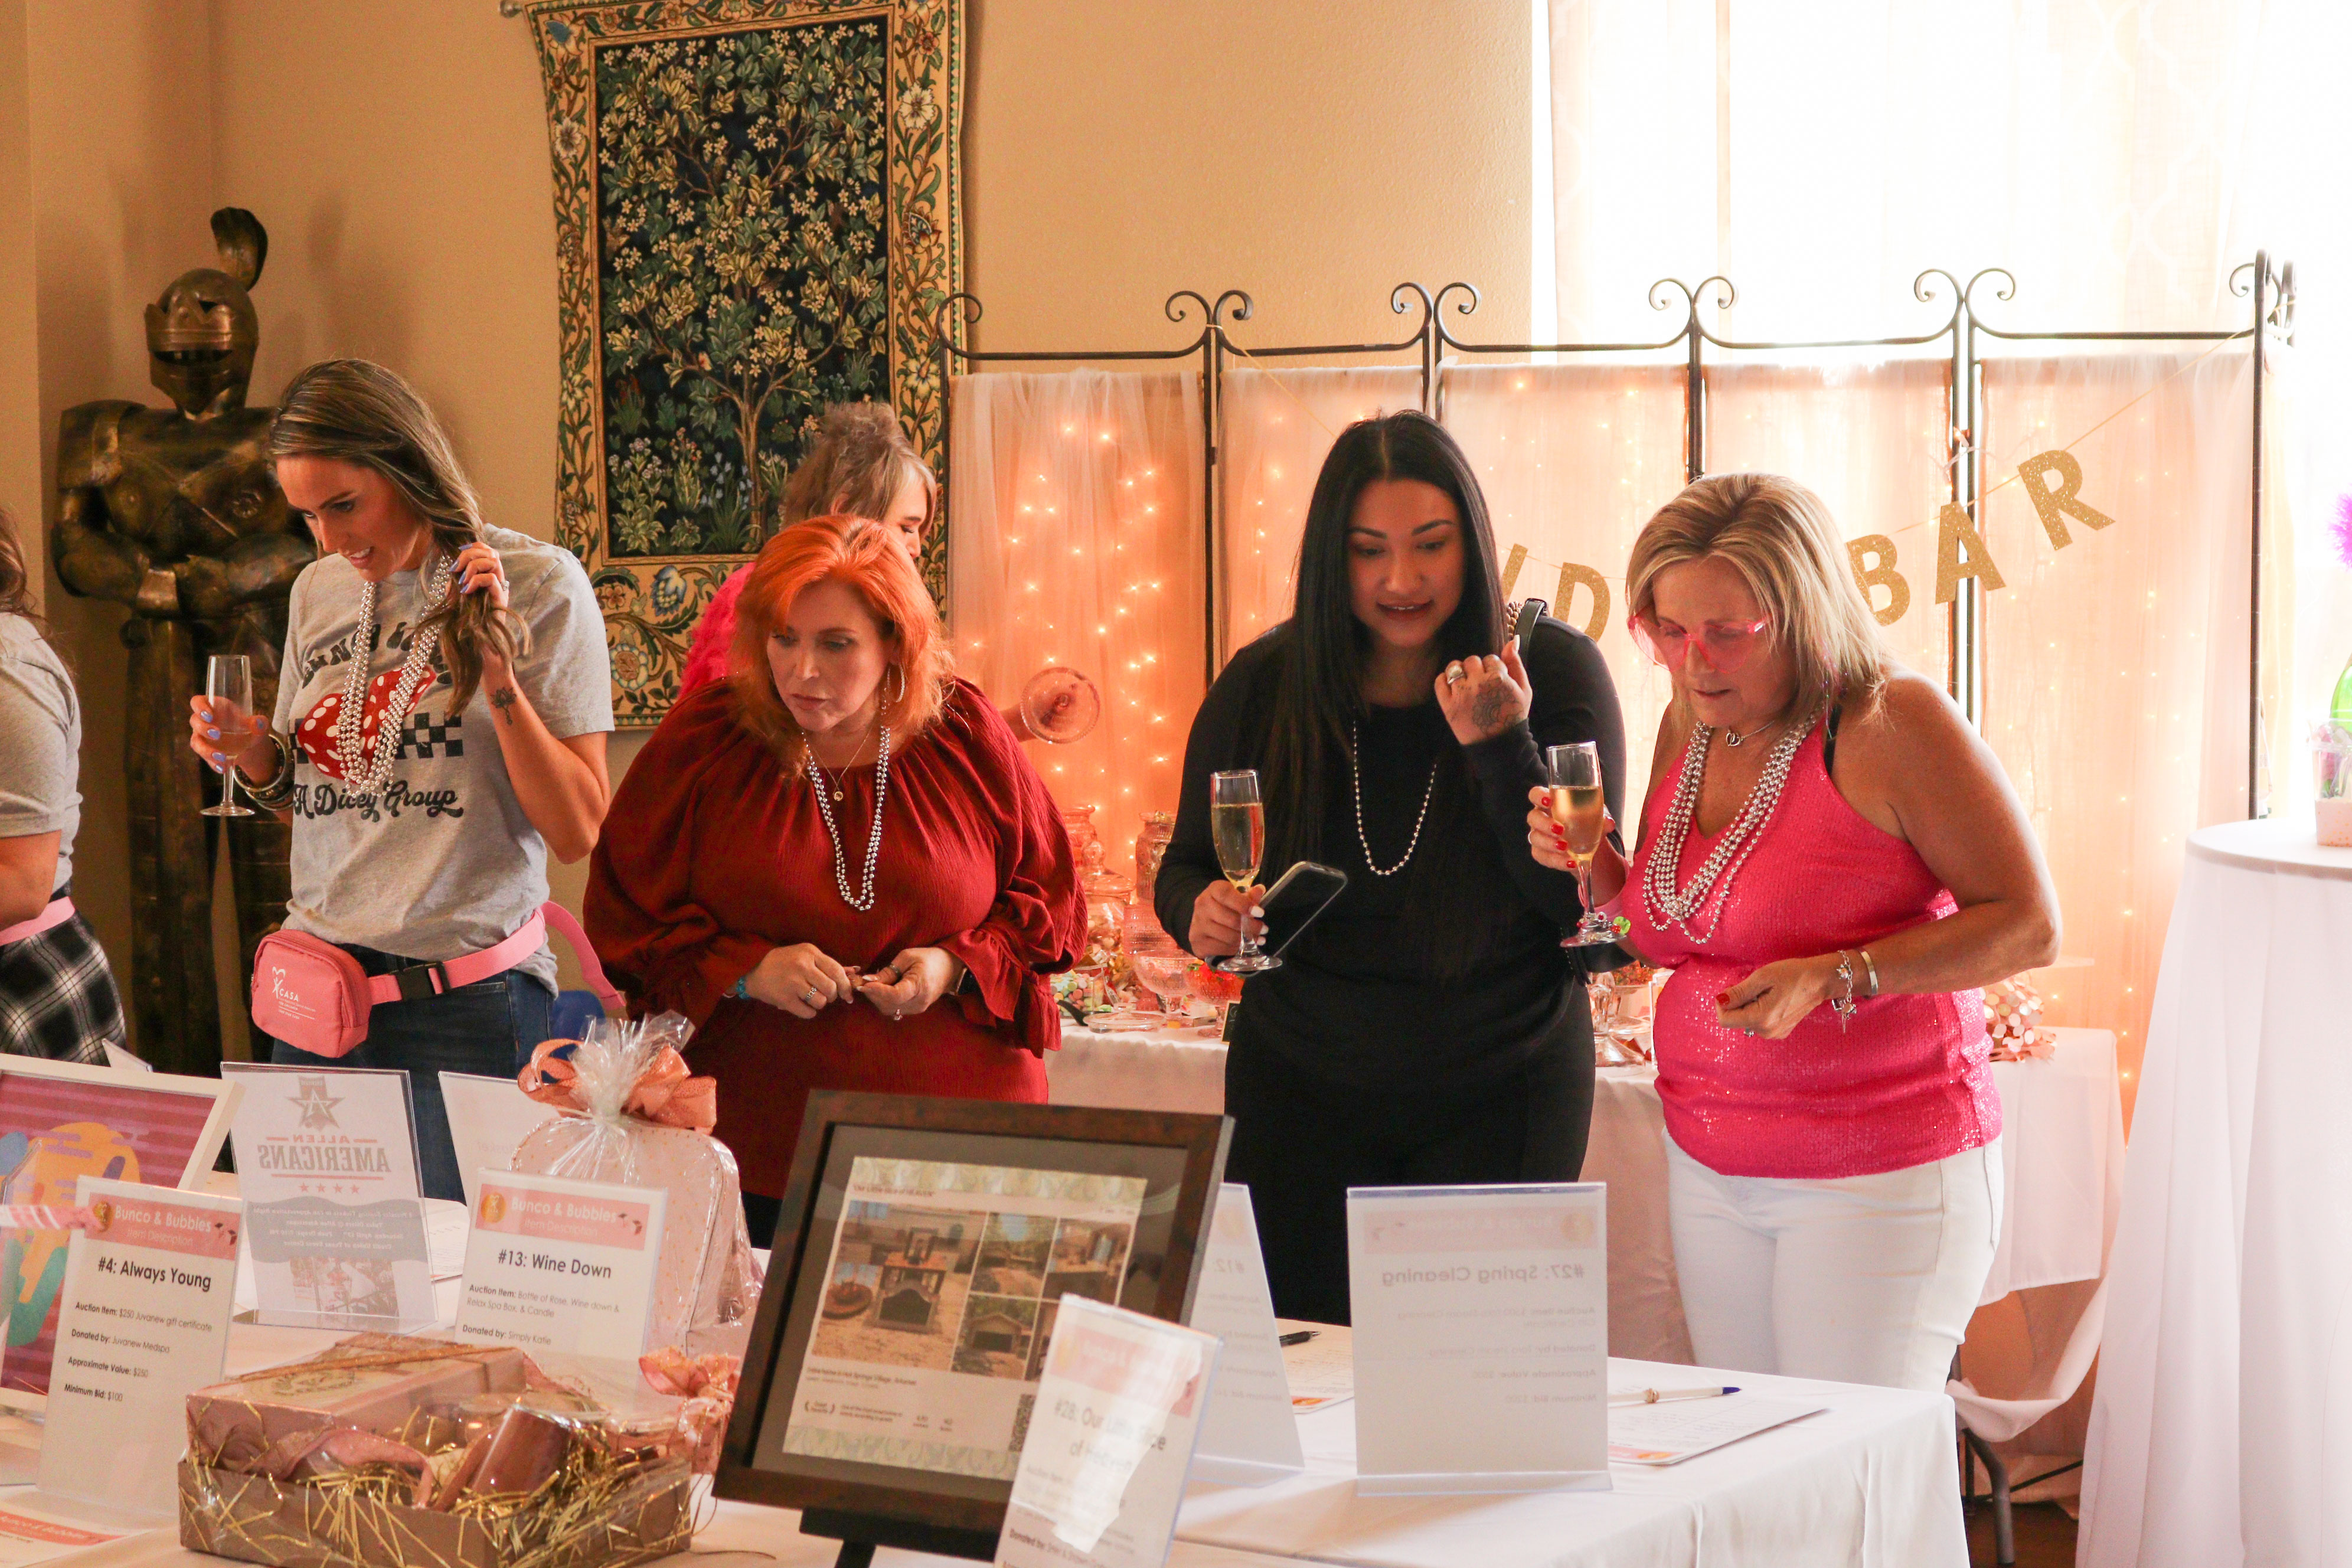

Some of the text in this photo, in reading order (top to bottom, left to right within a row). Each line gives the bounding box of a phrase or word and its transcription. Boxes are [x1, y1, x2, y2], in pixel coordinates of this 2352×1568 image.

[1845, 449, 2116, 628] BAR
[313, 783, 380, 823] Dicey
[383, 780, 464, 818] Group
[279, 988, 299, 1002] CASA
[115, 1204, 212, 1232] Bunco & Bubbles
[511, 1197, 618, 1223] Bunco & Bubbles
[524, 1219, 598, 1237] Item Description
[98, 1256, 211, 1292] #4: Always Young
[498, 1249, 612, 1279] #13: Wine Down
[467, 1297, 486, 1306] Relax
[488, 1300, 501, 1311] Spa
[527, 1306, 555, 1318] Candle
[469, 1284, 496, 1295] Auction
[498, 1288, 516, 1298] Item:
[518, 1291, 538, 1301] Bottle
[540, 1294, 548, 1302] of
[571, 1298, 589, 1308] Wine
[591, 1302, 612, 1311] down
[614, 1305, 619, 1313] &
[75, 1302, 213, 1332] Auction Item: $250 Juvanew gift certificate
[71, 1329, 170, 1354] Donated by: Juvanew Medspa
[462, 1324, 551, 1345] Donated by: Simply Katie
[68, 1356, 148, 1378] Approximate Value: $250
[64, 1383, 123, 1402] Minimum Bid: $100
